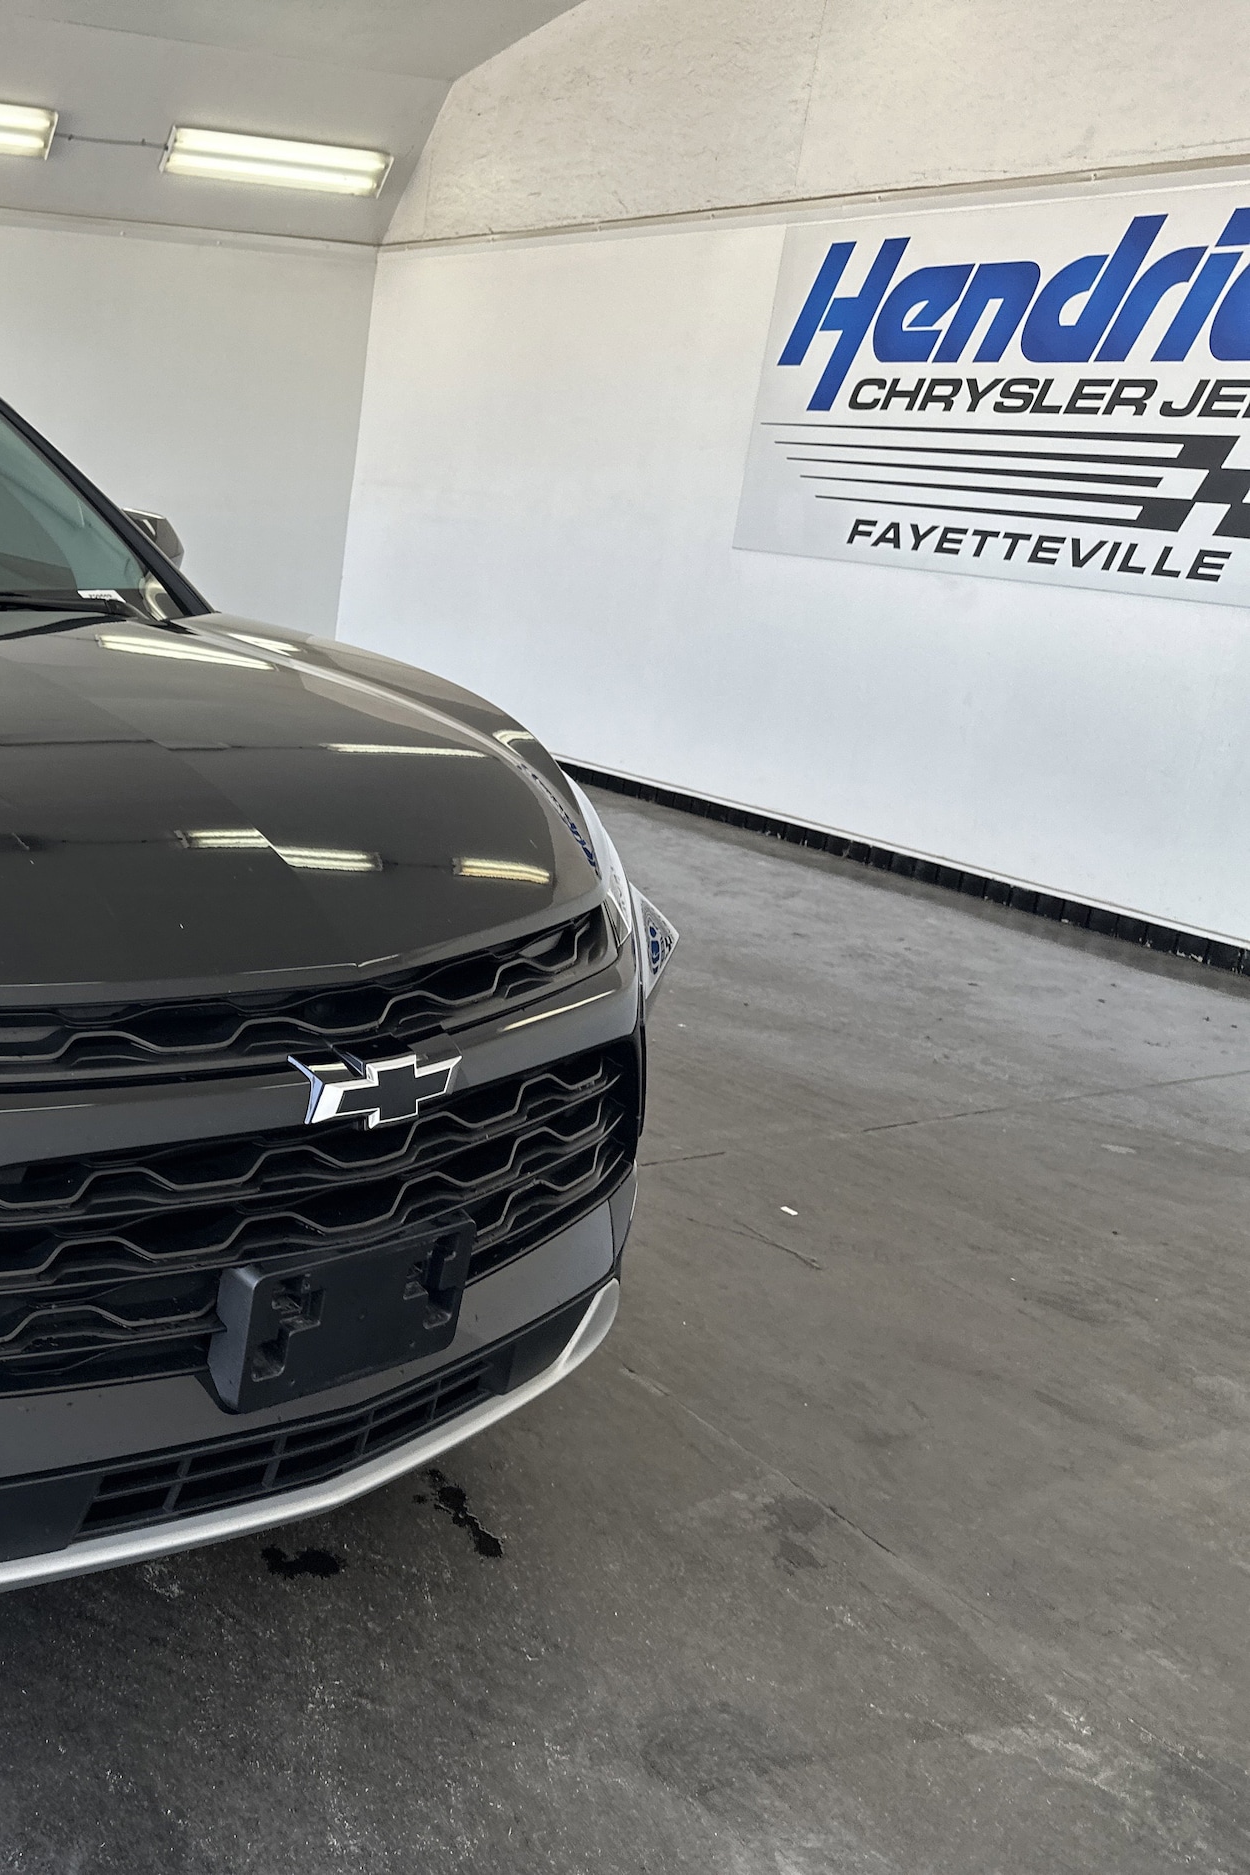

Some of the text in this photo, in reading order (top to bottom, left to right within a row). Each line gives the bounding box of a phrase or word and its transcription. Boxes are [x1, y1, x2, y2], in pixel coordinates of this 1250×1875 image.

[848, 377, 1250, 418] CHRYSLER JE
[846, 519, 1232, 583] FAYETTEVILLE
